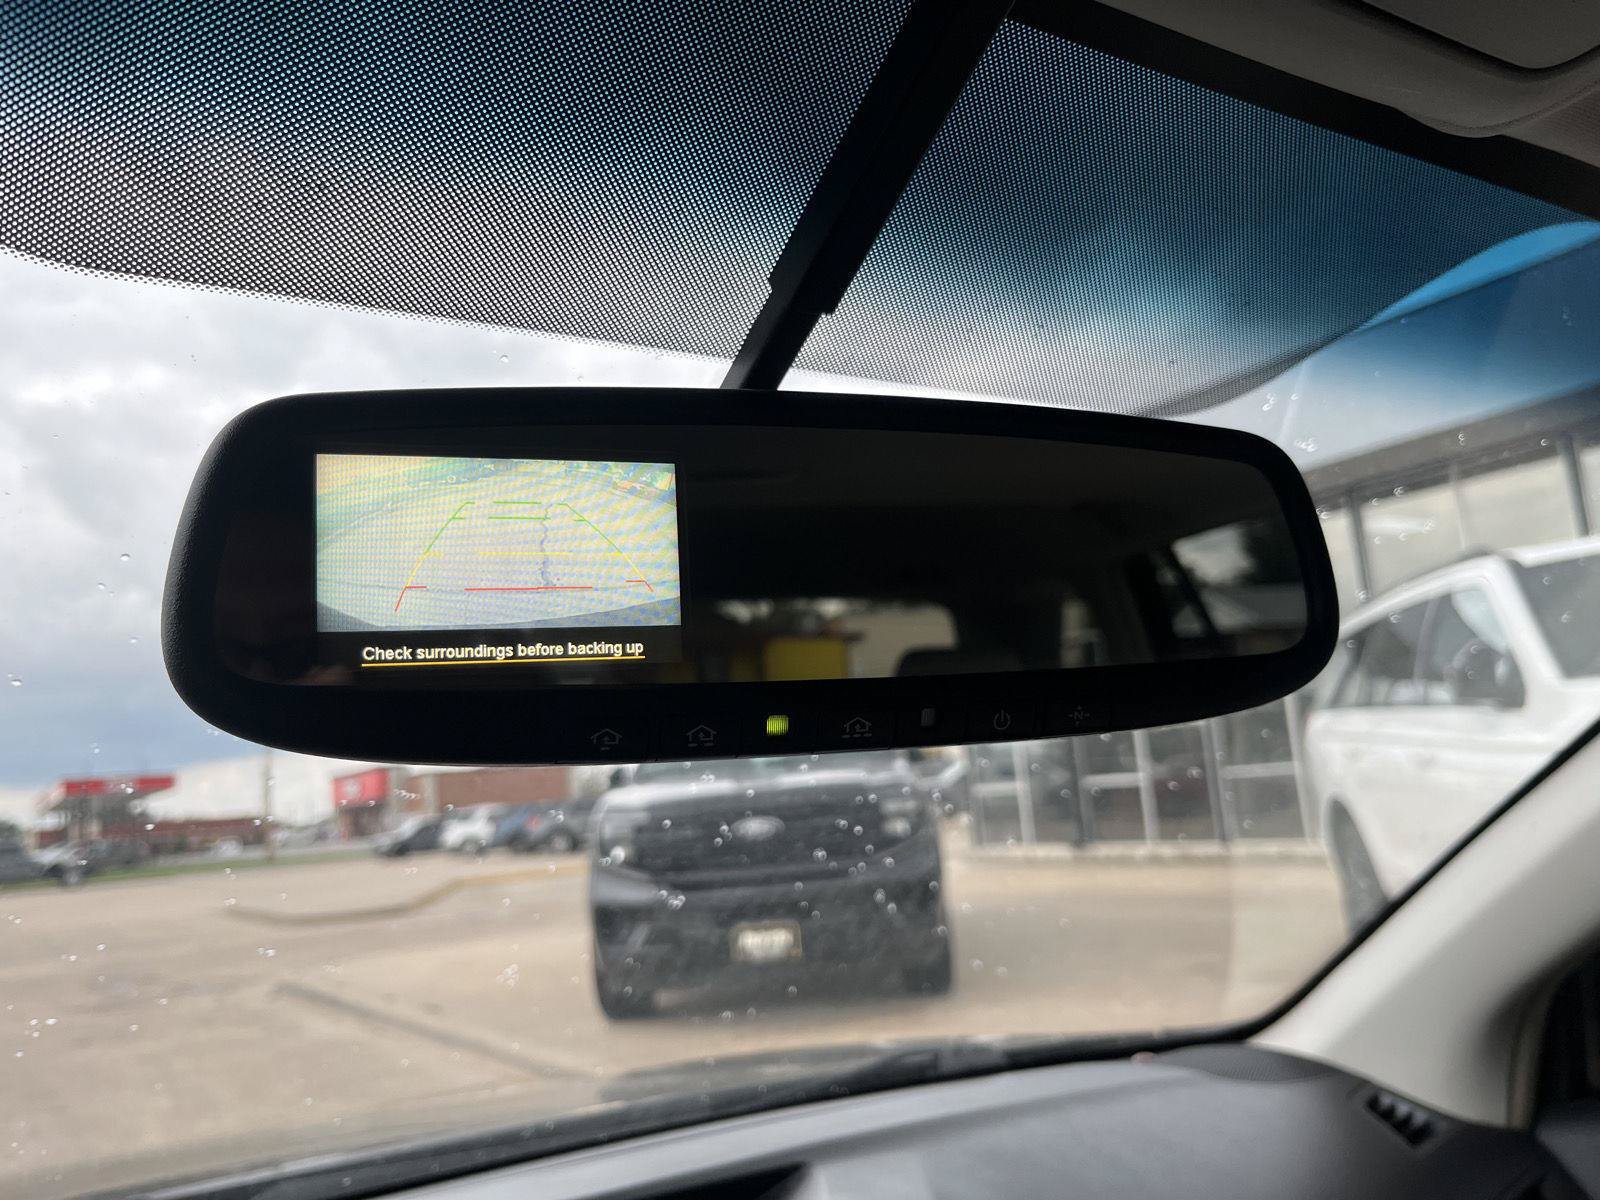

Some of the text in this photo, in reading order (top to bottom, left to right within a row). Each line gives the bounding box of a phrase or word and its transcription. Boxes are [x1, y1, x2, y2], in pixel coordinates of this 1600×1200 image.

[362, 641, 644, 661] Check surroundings before backing up
